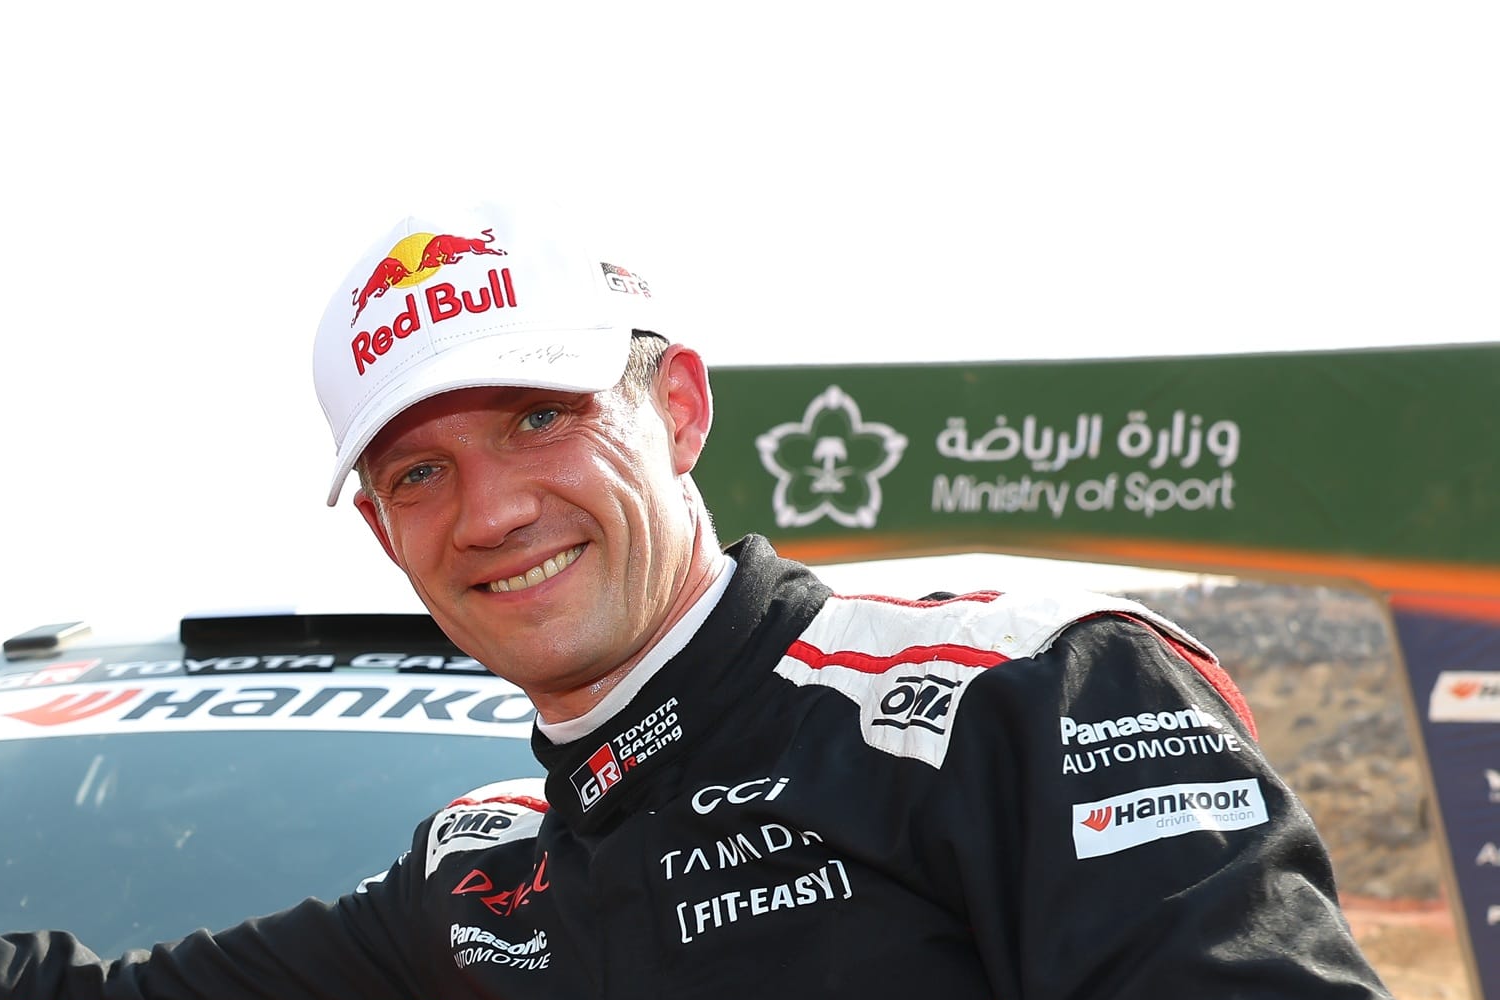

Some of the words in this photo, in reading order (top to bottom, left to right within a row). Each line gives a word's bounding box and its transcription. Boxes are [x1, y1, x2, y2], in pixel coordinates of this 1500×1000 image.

[351, 293, 421, 376] Red
[425, 268, 518, 324] Bull
[936, 414, 1103, 472] الرياضة
[1117, 410, 1240, 469] وزارة
[931, 474, 1070, 519] Ministry
[1074, 471, 1120, 512] of
[1123, 471, 1237, 518] Sport
[105, 653, 332, 678] TOYOTA
[350, 652, 488, 672] GAZ
[612, 696, 679, 747] TOYOTA
[619, 712, 678, 760] GAZOO
[622, 724, 683, 772] Racing
[1062, 733, 1242, 775] AUTOMOTIVE
[580, 760, 620, 806] GR
[450, 923, 548, 956] Panasonic
